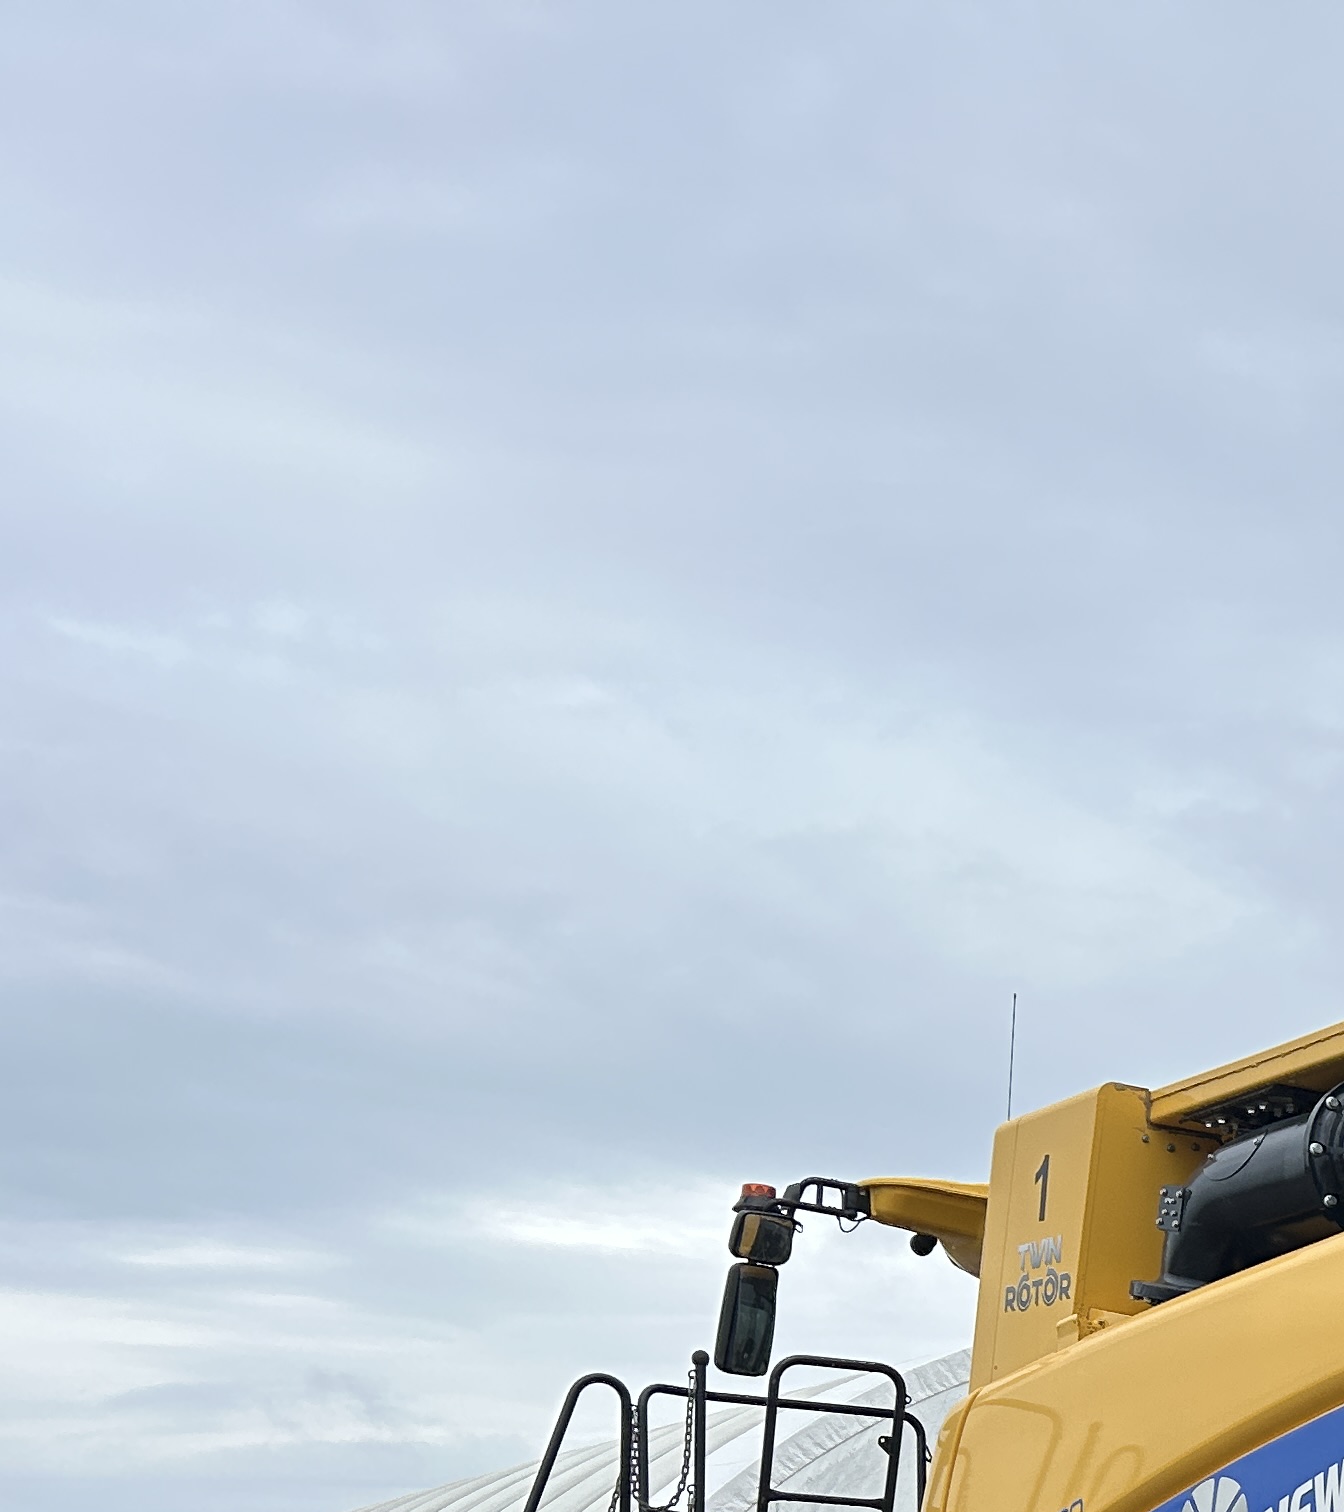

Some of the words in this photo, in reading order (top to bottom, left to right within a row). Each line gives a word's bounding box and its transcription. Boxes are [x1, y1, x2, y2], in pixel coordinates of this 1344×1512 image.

[1034, 1154, 1050, 1222] 1
[1018, 1234, 1063, 1272] TWIN
[1004, 1266, 1071, 1313] ROTOR
